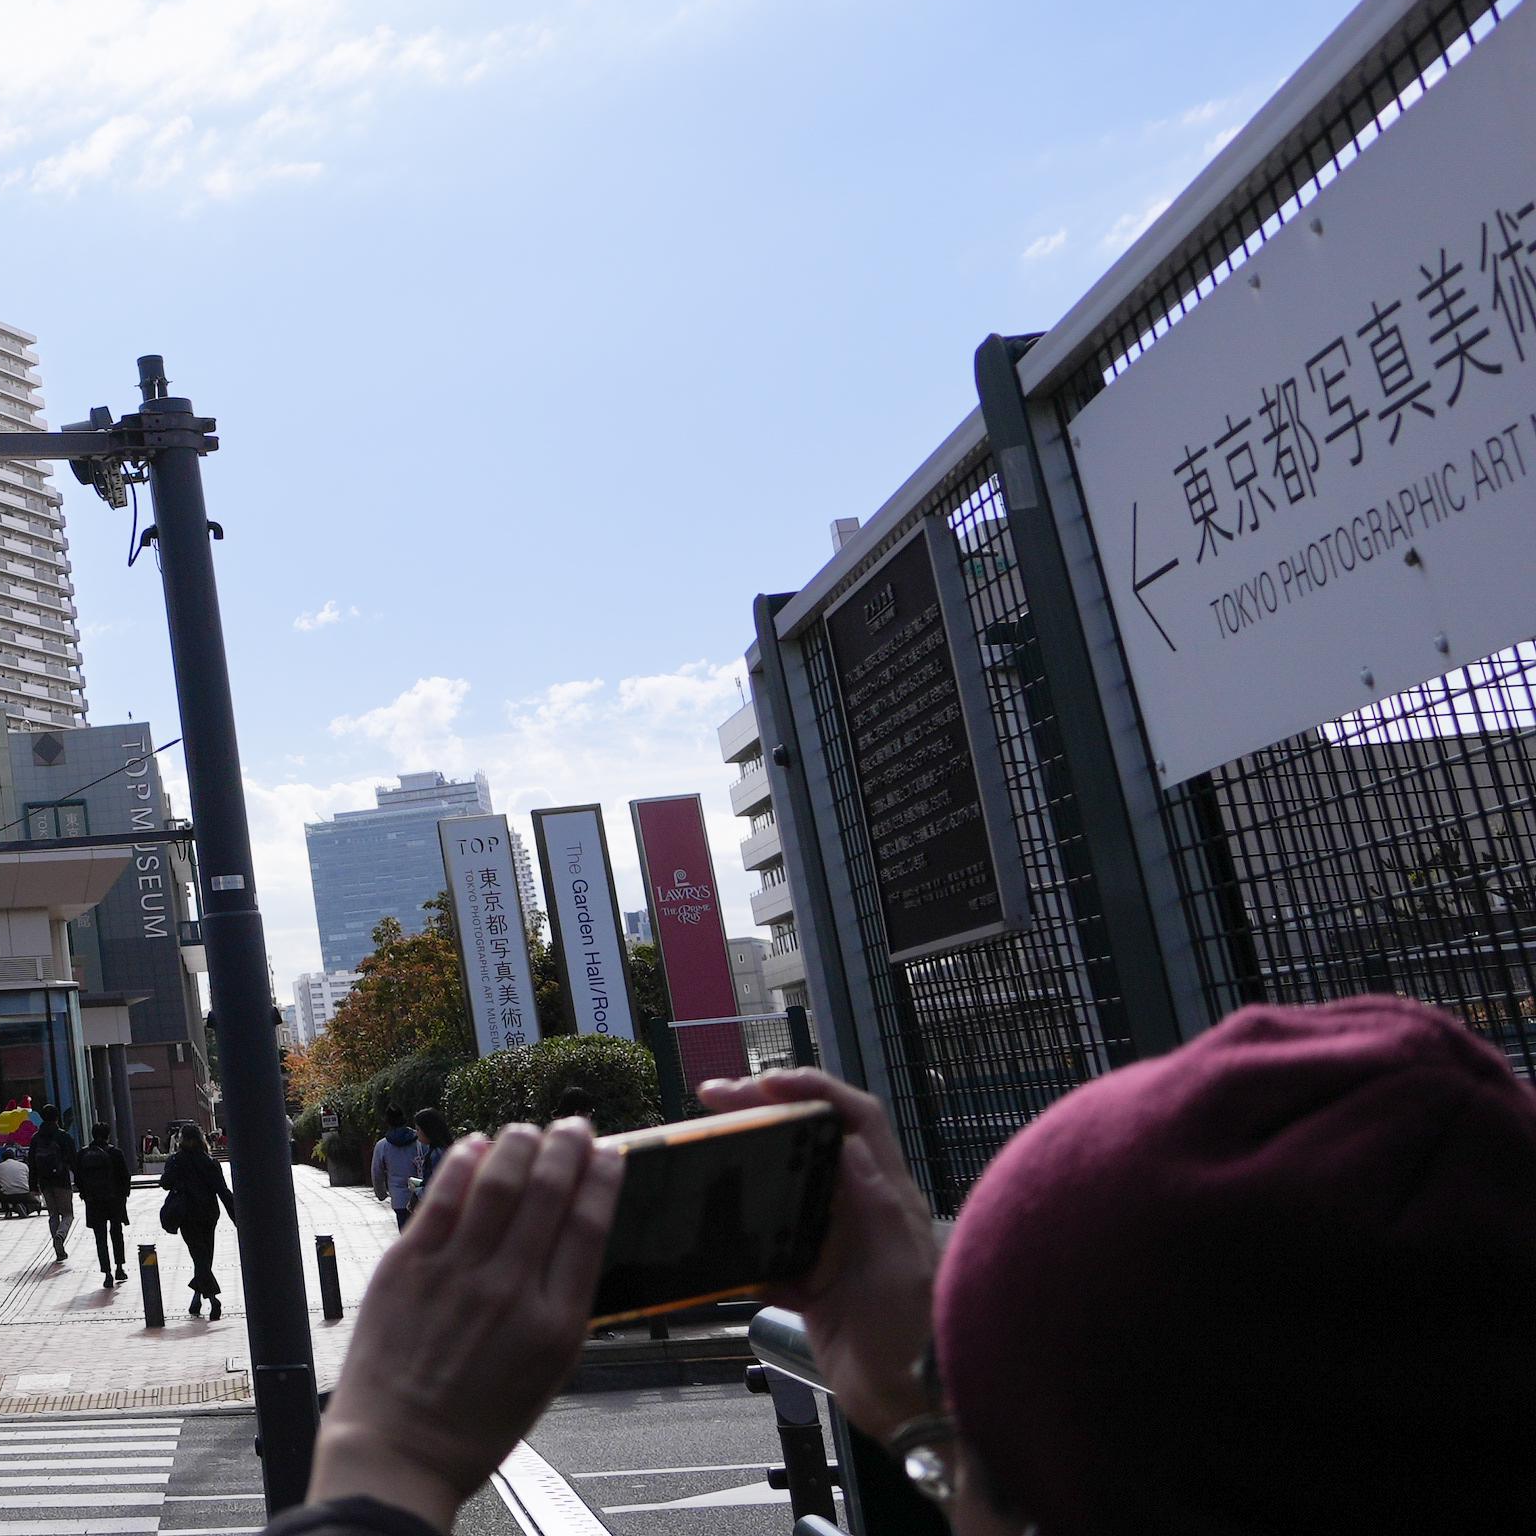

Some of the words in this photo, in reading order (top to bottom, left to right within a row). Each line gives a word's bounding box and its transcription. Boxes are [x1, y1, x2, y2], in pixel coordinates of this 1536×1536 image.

[1210, 571, 1278, 639] TOKYO
[1278, 462, 1467, 604] PHOTOGRAPHIC
[1470, 423, 1527, 501] ART
[121, 735, 151, 800] TOP
[129, 807, 168, 939] MUSEUM
[456, 836, 500, 856] TOP
[566, 841, 583, 875] The
[464, 870, 478, 902] TOKYO
[471, 904, 490, 982] PHOTOGRAPHIC
[483, 986, 494, 1004] ART
[478, 867, 527, 1049] 東京都写真美術館
[572, 879, 596, 946] Garden
